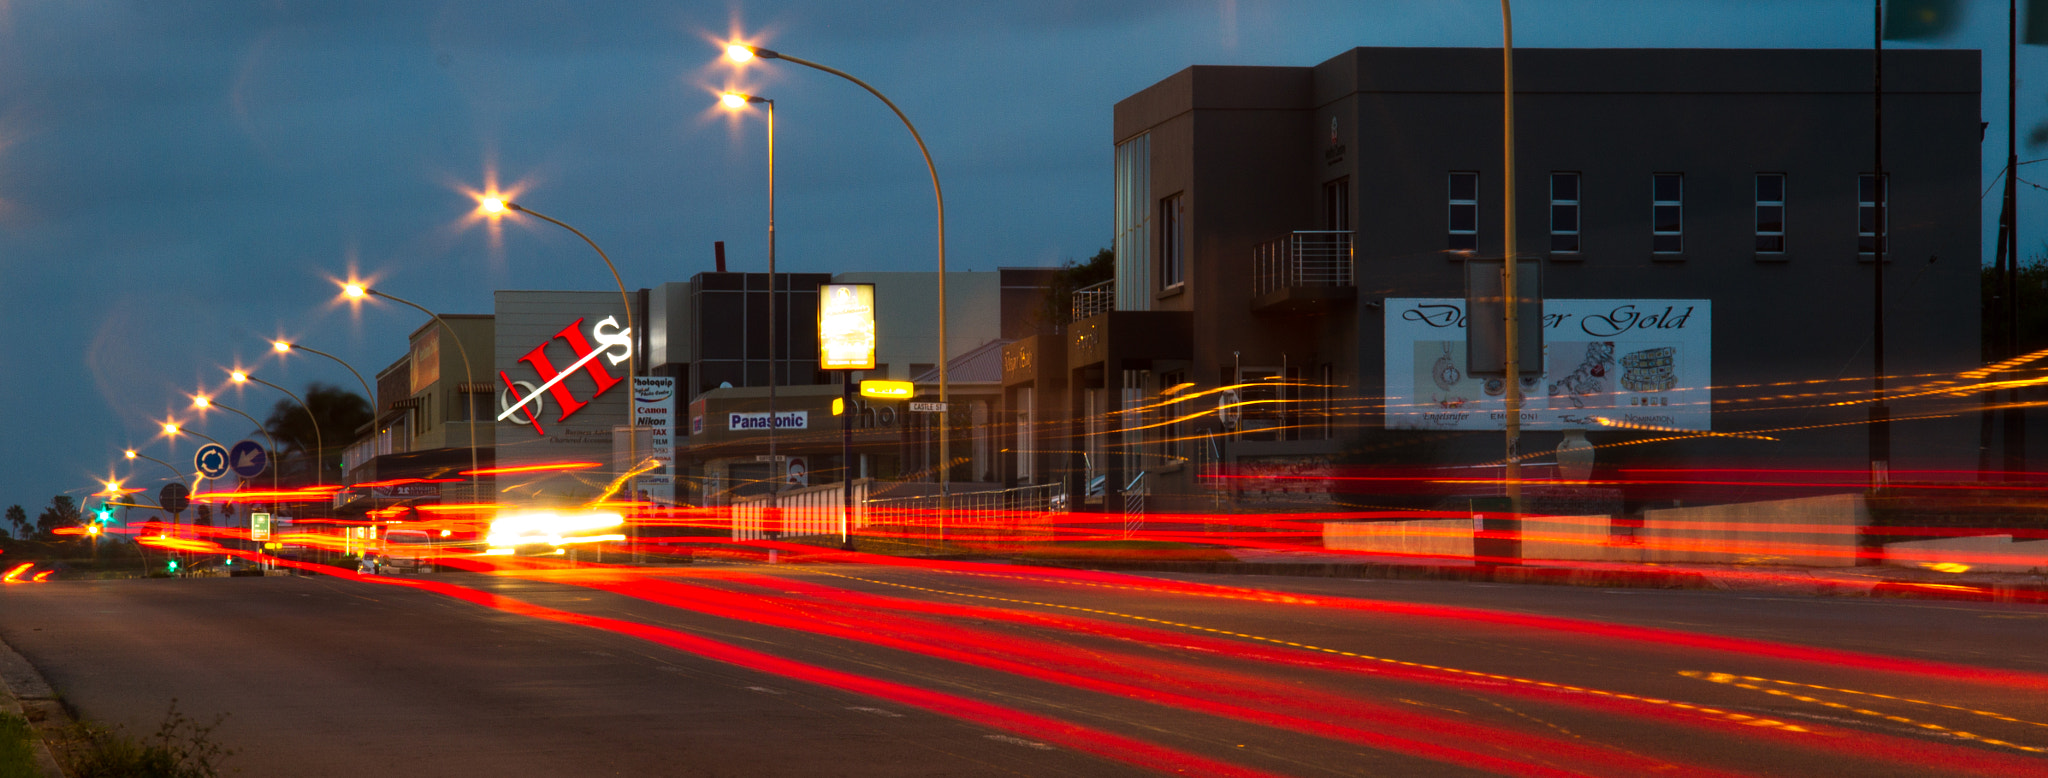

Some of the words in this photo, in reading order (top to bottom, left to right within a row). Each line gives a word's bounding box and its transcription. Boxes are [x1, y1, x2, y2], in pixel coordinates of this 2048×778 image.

[1581, 305, 1694, 337] Gold
[637, 406, 667, 414] Canon
[637, 417, 666, 425] Nikon
[1624, 413, 1674, 425] NOMINATION
